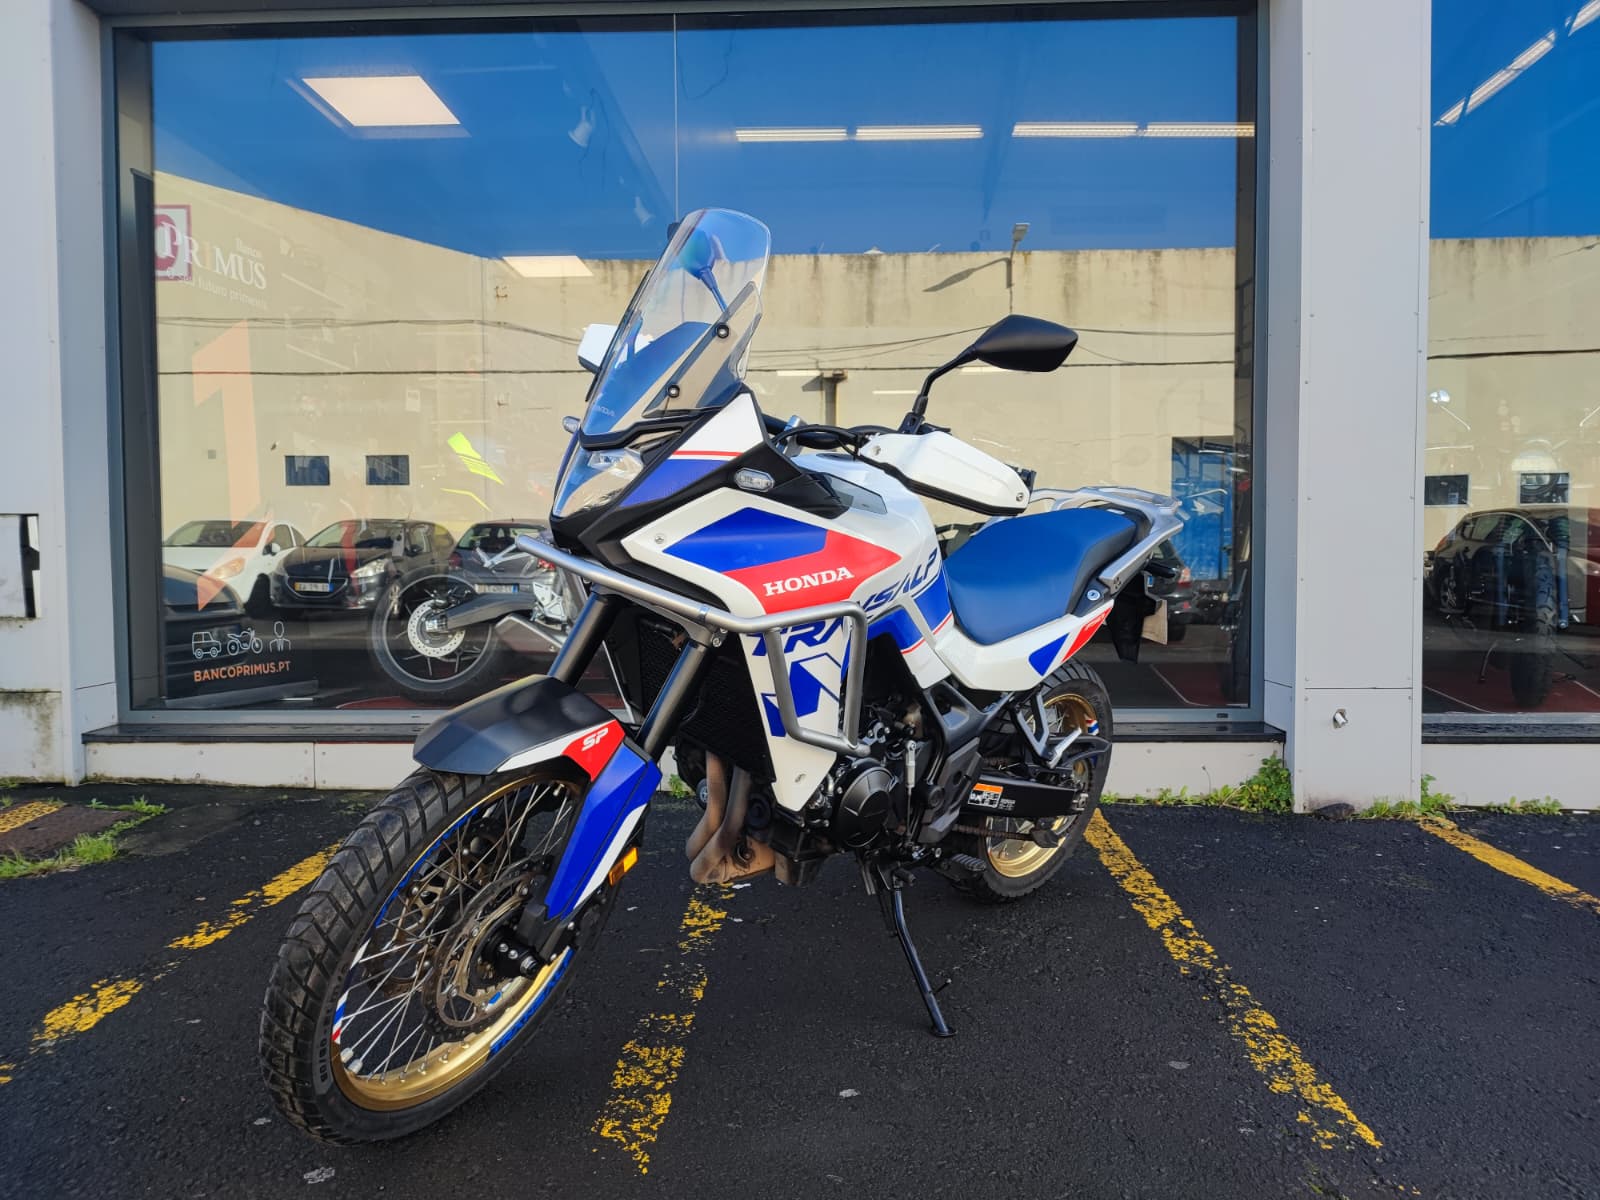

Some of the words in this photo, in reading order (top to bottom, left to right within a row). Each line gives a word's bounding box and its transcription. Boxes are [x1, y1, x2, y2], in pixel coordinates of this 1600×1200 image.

[763, 566, 855, 597] HONDA
[193, 661, 292, 682] BANCOPRIMUS.PT
[581, 727, 609, 752] SP
